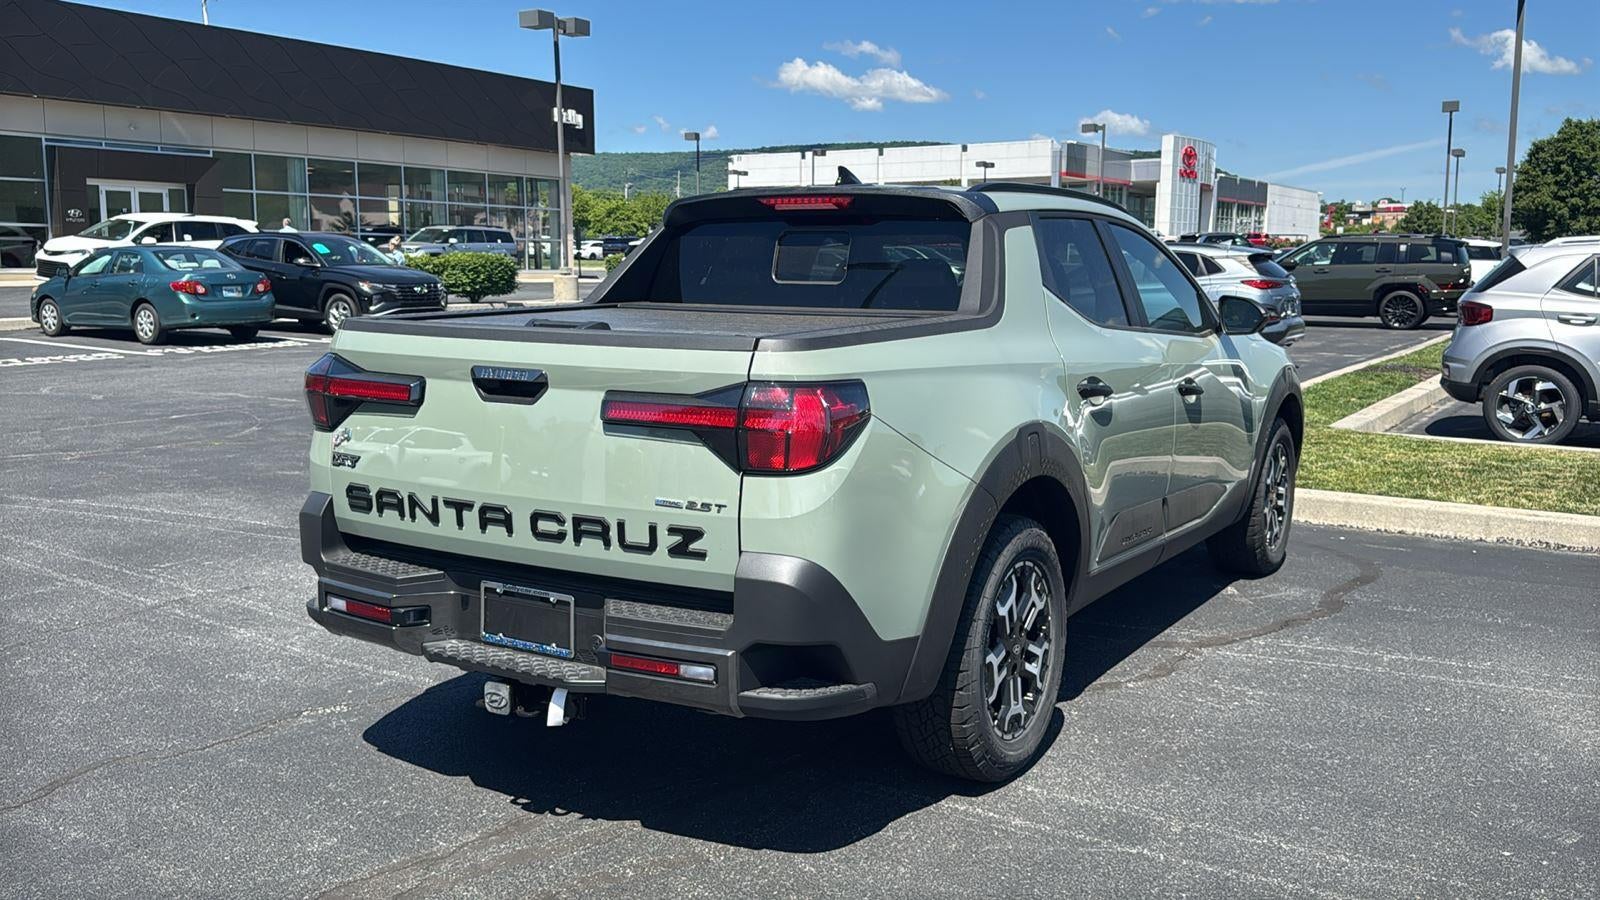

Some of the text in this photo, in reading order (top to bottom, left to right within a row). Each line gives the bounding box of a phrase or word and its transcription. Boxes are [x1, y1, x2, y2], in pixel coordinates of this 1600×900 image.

[480, 368, 529, 381] HYUNDAI
[346, 482, 708, 562] SANTA CRUZ
